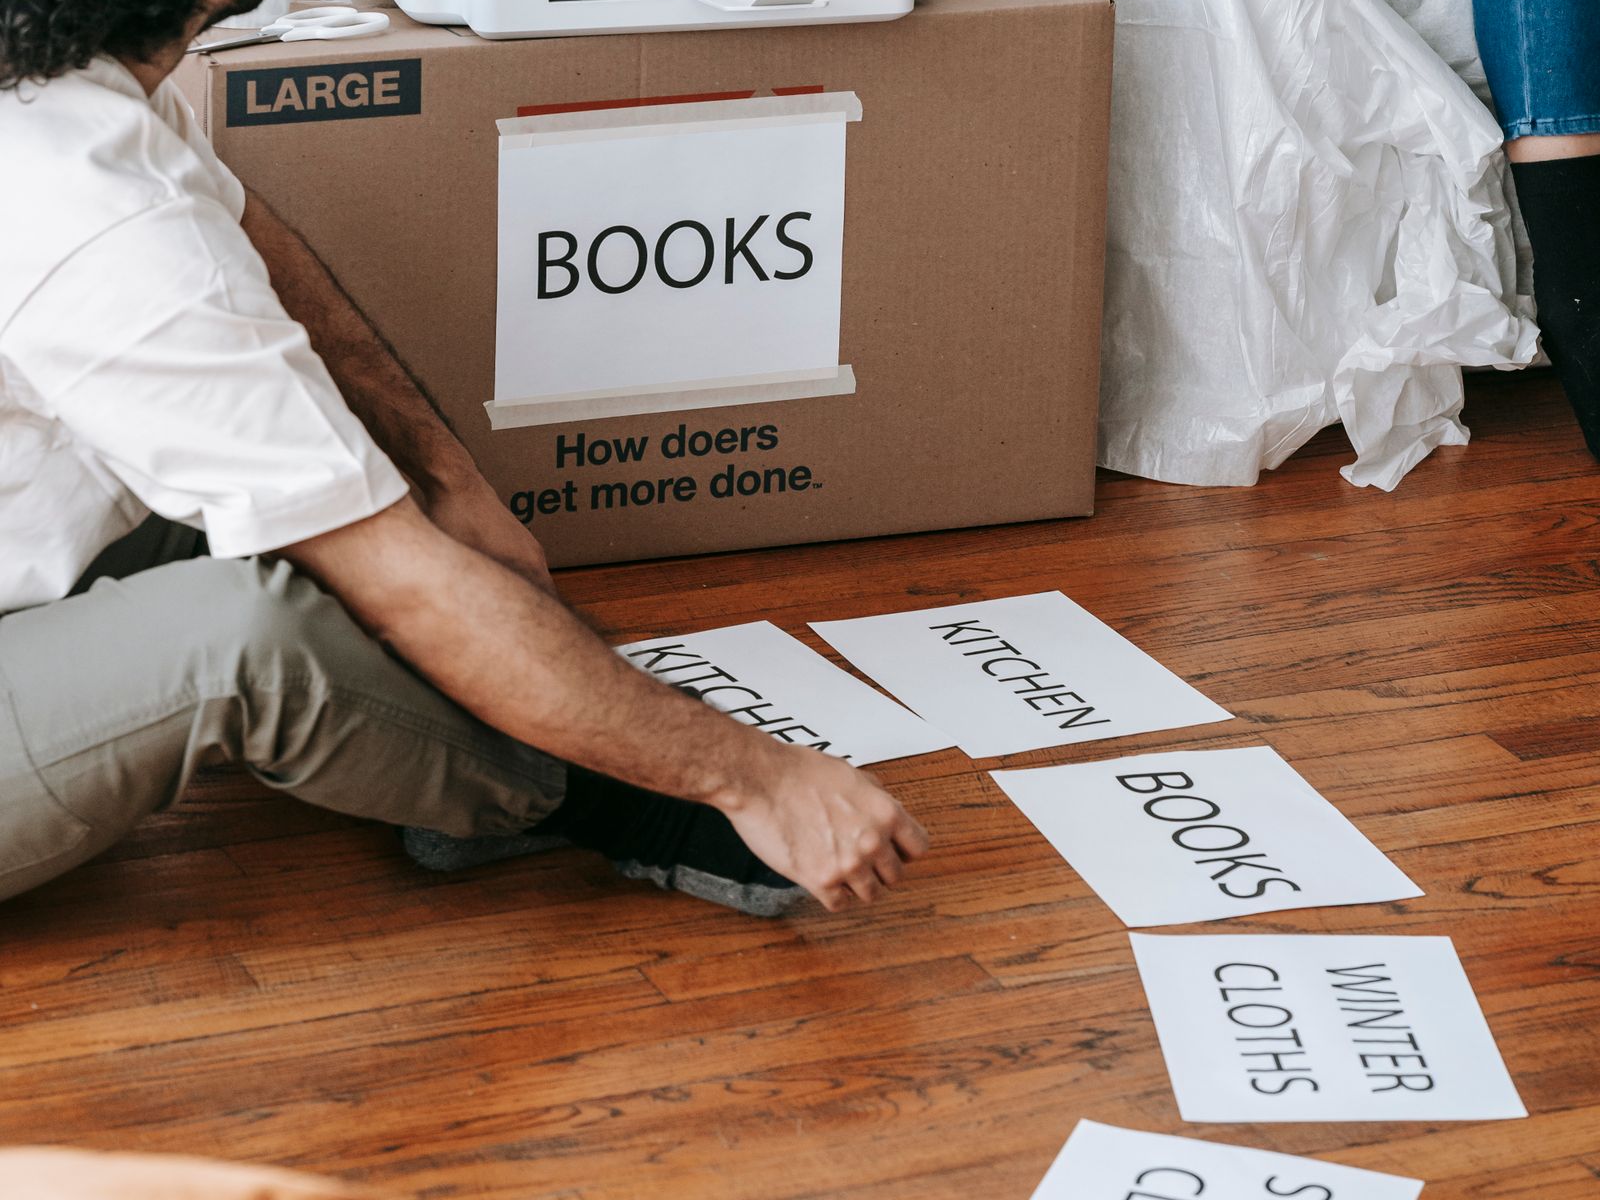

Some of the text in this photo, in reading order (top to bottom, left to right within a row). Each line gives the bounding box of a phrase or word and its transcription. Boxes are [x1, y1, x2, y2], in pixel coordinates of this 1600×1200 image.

[246, 70, 400, 114] LARGE
[537, 211, 814, 300] BOOKS
[556, 424, 779, 468] How doers
[510, 480, 578, 524] get
[590, 475, 697, 510] more
[929, 620, 1112, 730] KITCHEN
[1115, 771, 1302, 899] BOOKS
[1213, 963, 1319, 1095] CLOTHS
[1325, 963, 1435, 1093] WINTER
